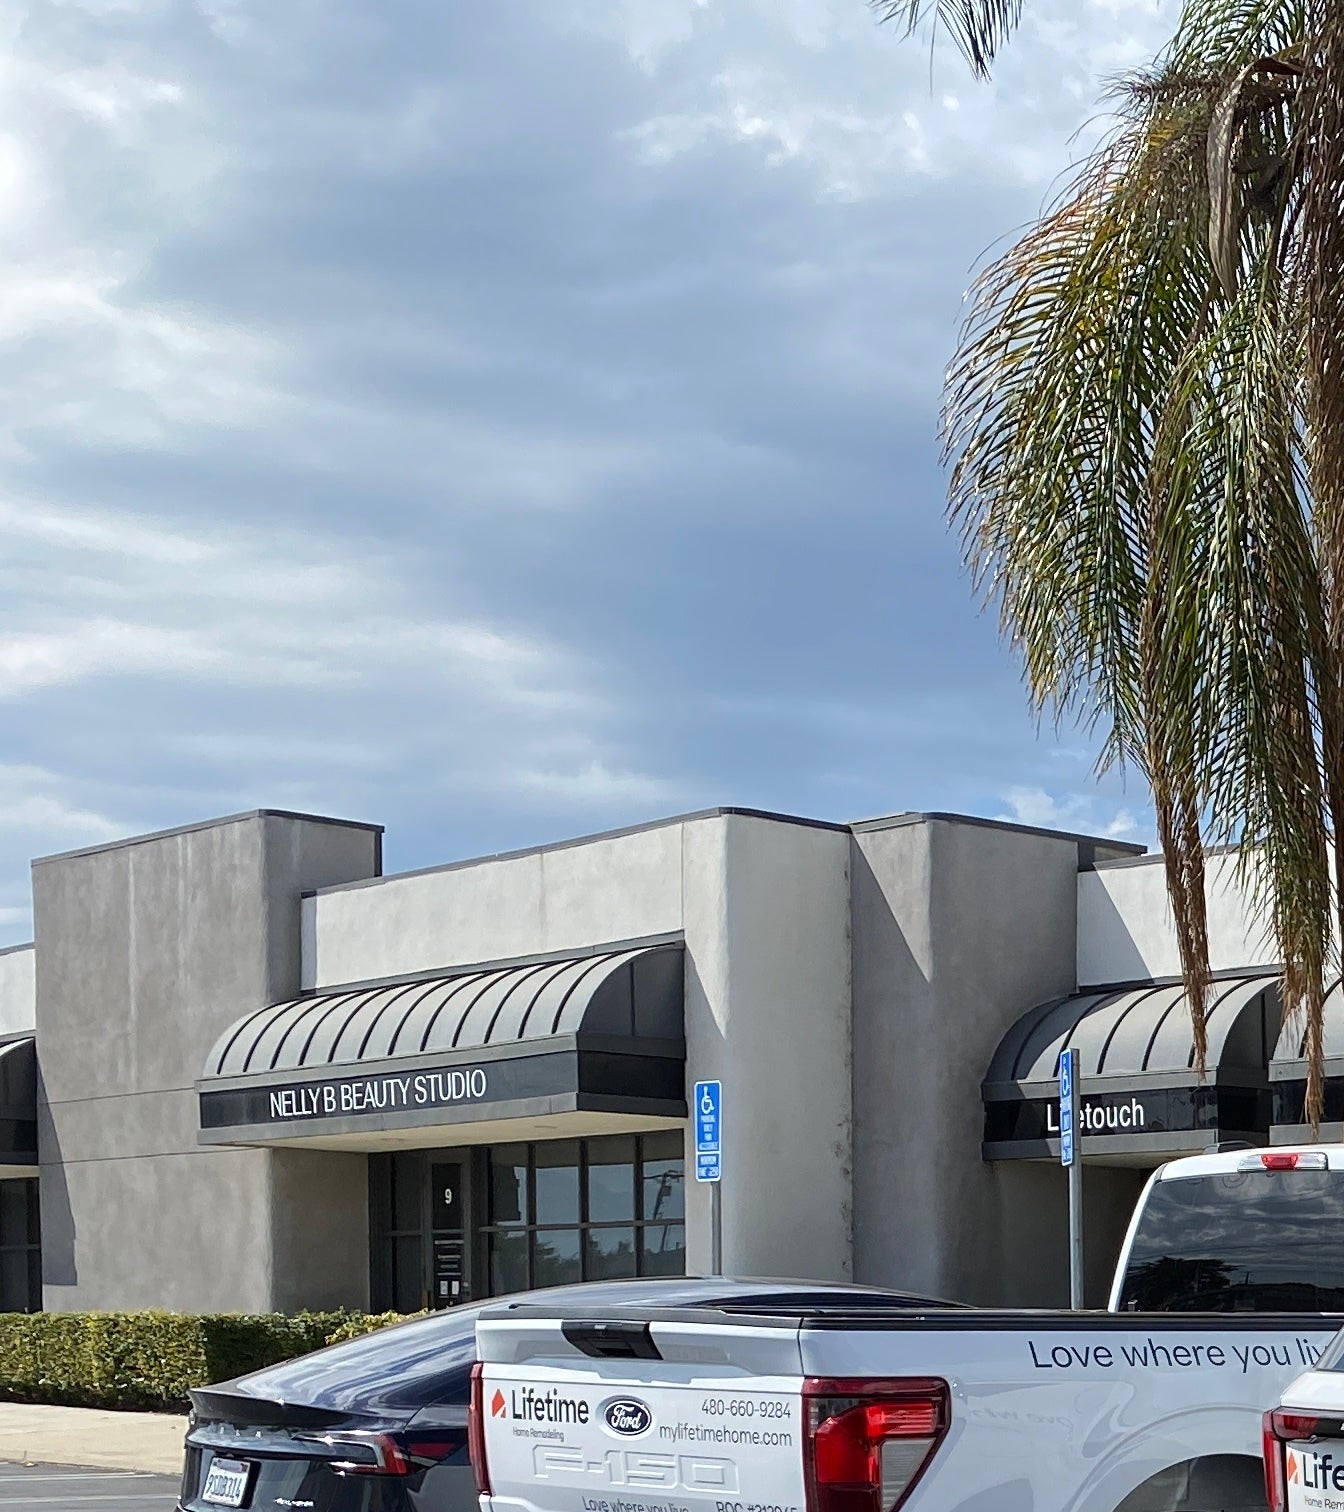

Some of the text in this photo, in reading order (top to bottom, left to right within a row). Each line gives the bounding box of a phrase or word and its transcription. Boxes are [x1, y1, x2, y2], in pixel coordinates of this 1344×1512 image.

[270, 1069, 487, 1117] NELLY B BEAUTY STUDIO
[1046, 1097, 1145, 1131] Letouch
[444, 1188, 452, 1204] 9
[1028, 1338, 1329, 1373] Love where you liv
[511, 1386, 590, 1425] Lifetime
[701, 1399, 792, 1418] 480-660-9284
[659, 1422, 793, 1446] mylifetimehome.com
[532, 1443, 741, 1495] F-150
